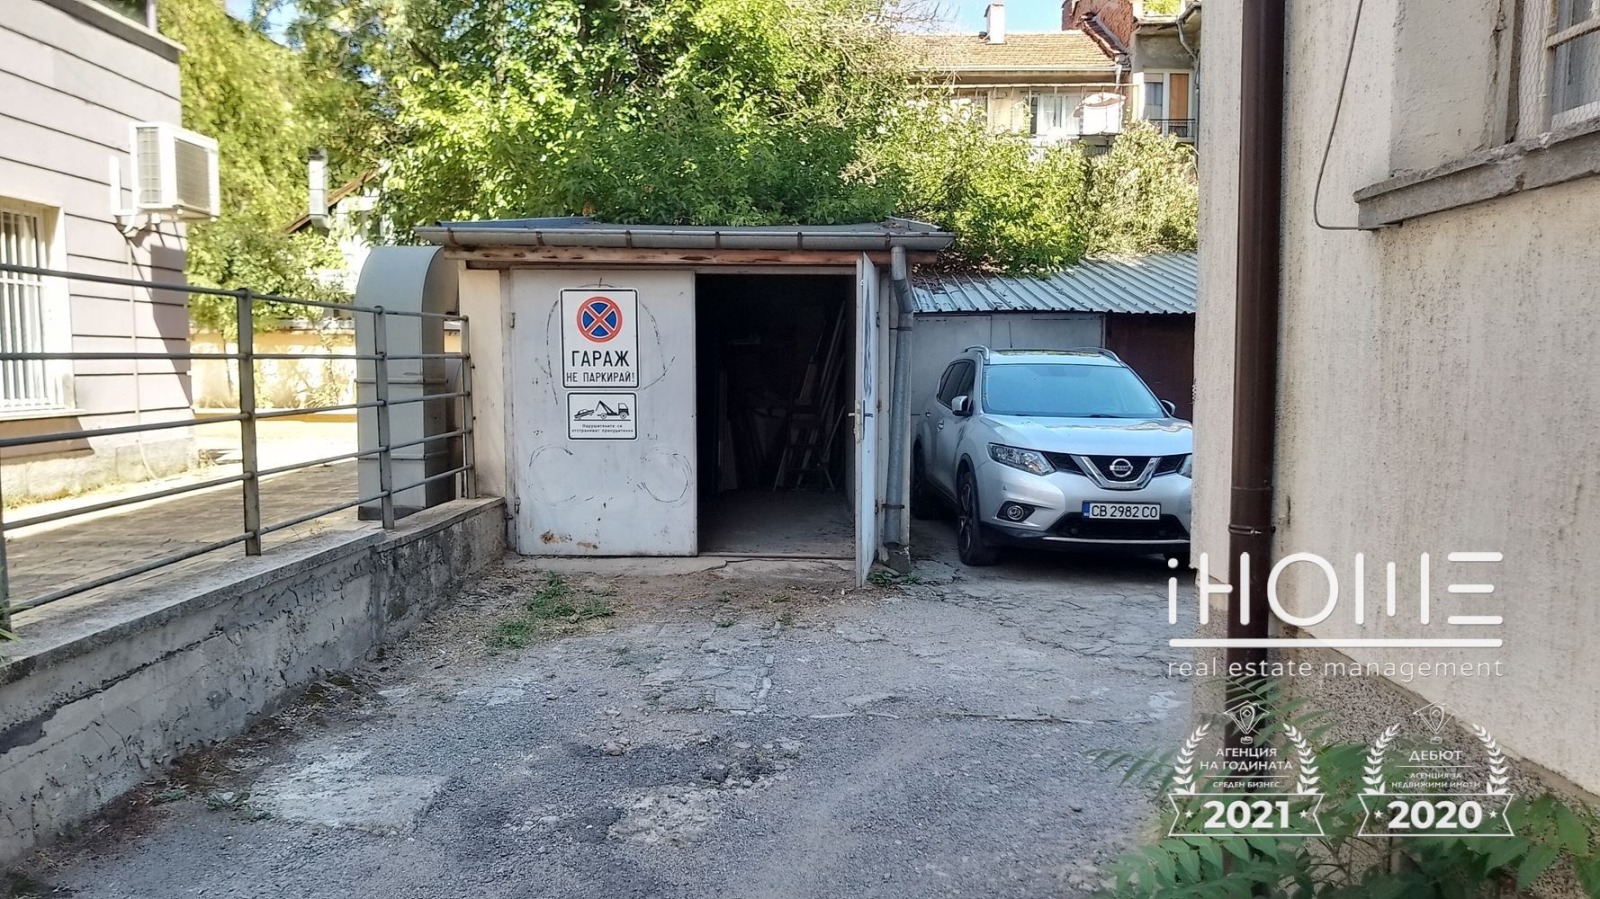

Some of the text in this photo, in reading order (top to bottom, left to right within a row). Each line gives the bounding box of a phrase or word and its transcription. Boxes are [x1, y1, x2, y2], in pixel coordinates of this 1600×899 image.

[571, 350, 630, 367] ГАРАЖ
[566, 371, 635, 382] НЕ ПАРКИРАЙ!
[1091, 505, 1107, 517] CB
[1110, 506, 1140, 518] 2982
